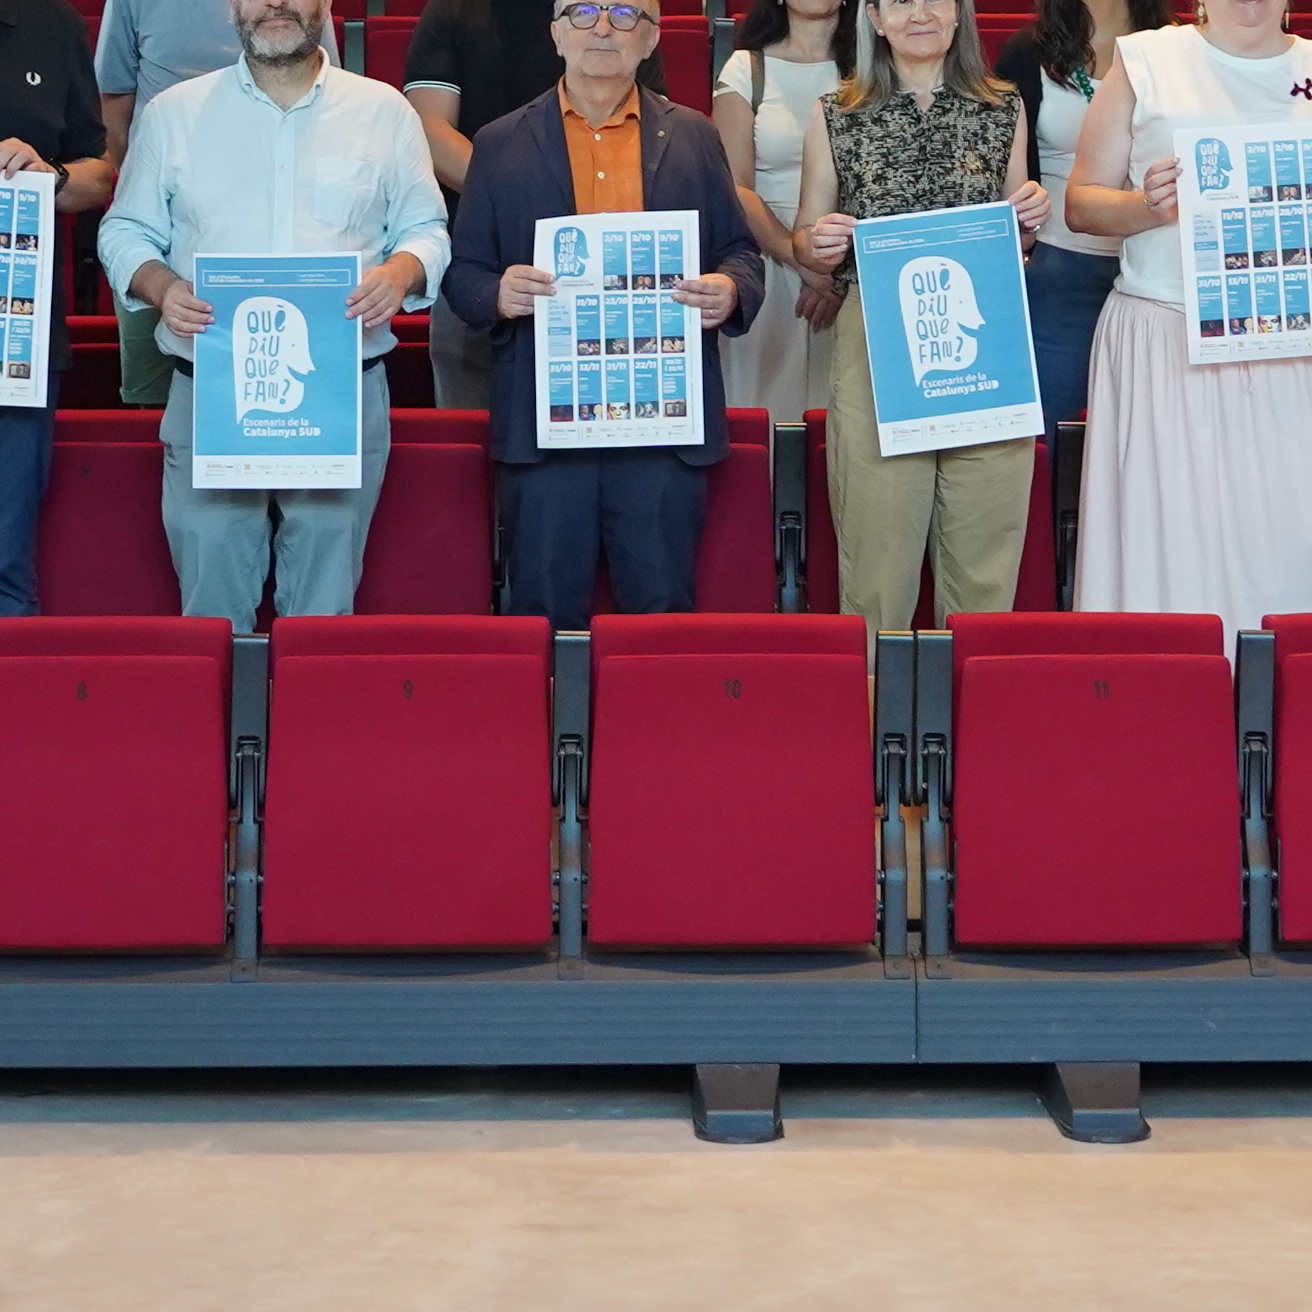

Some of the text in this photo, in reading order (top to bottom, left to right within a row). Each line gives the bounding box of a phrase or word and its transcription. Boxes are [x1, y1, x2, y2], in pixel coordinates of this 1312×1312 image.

[632, 233, 651, 242] 2/10
[922, 372, 987, 389] Escenaris de la
[924, 380, 1000, 399] Catalunya SUD
[243, 417, 309, 427] Escenaris de la
[243, 427, 322, 439] Catalunya SUD
[403, 679, 414, 700] 9
[723, 679, 742, 699] 10
[1093, 679, 1111, 699] 11
